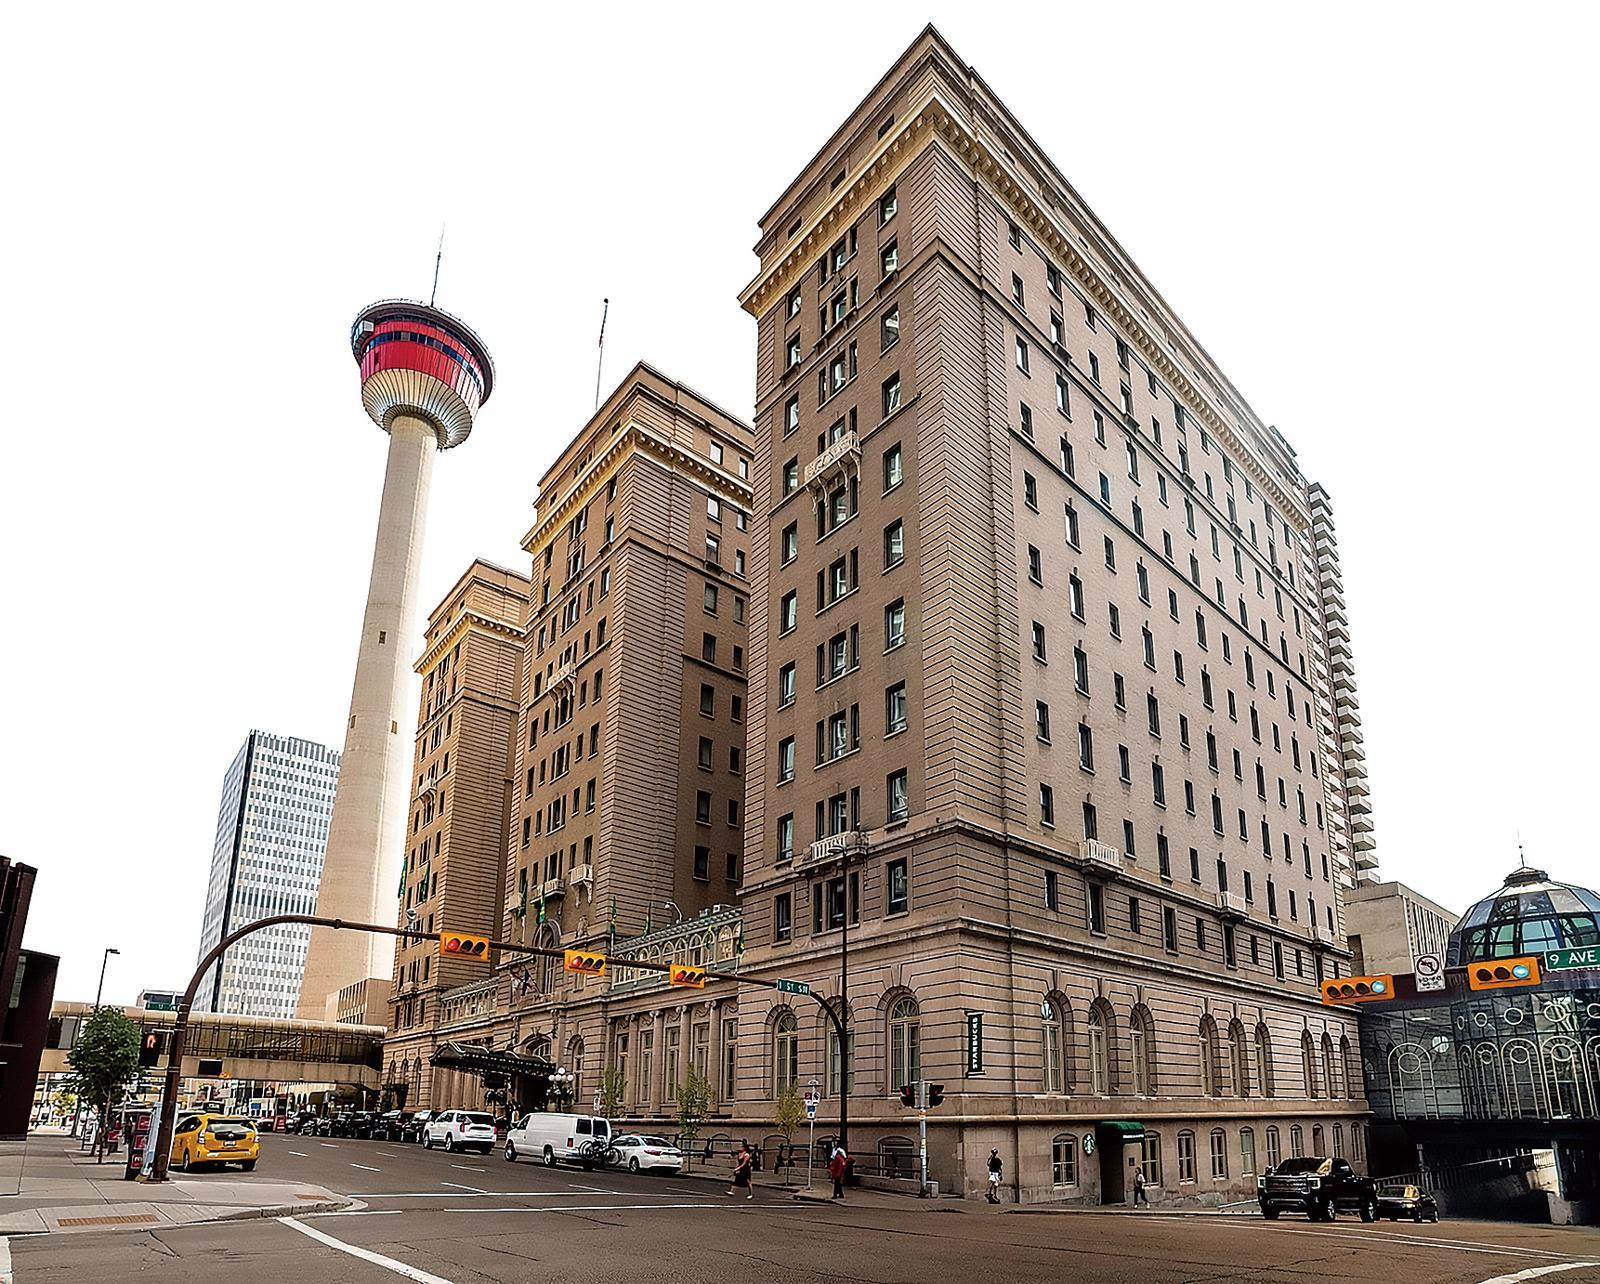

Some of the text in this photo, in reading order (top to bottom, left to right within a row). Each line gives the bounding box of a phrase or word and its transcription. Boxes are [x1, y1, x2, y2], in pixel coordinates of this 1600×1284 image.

[1549, 950, 1598, 965] 9 AVE
[786, 982, 795, 991] ST
[798, 984, 808, 994] SW
